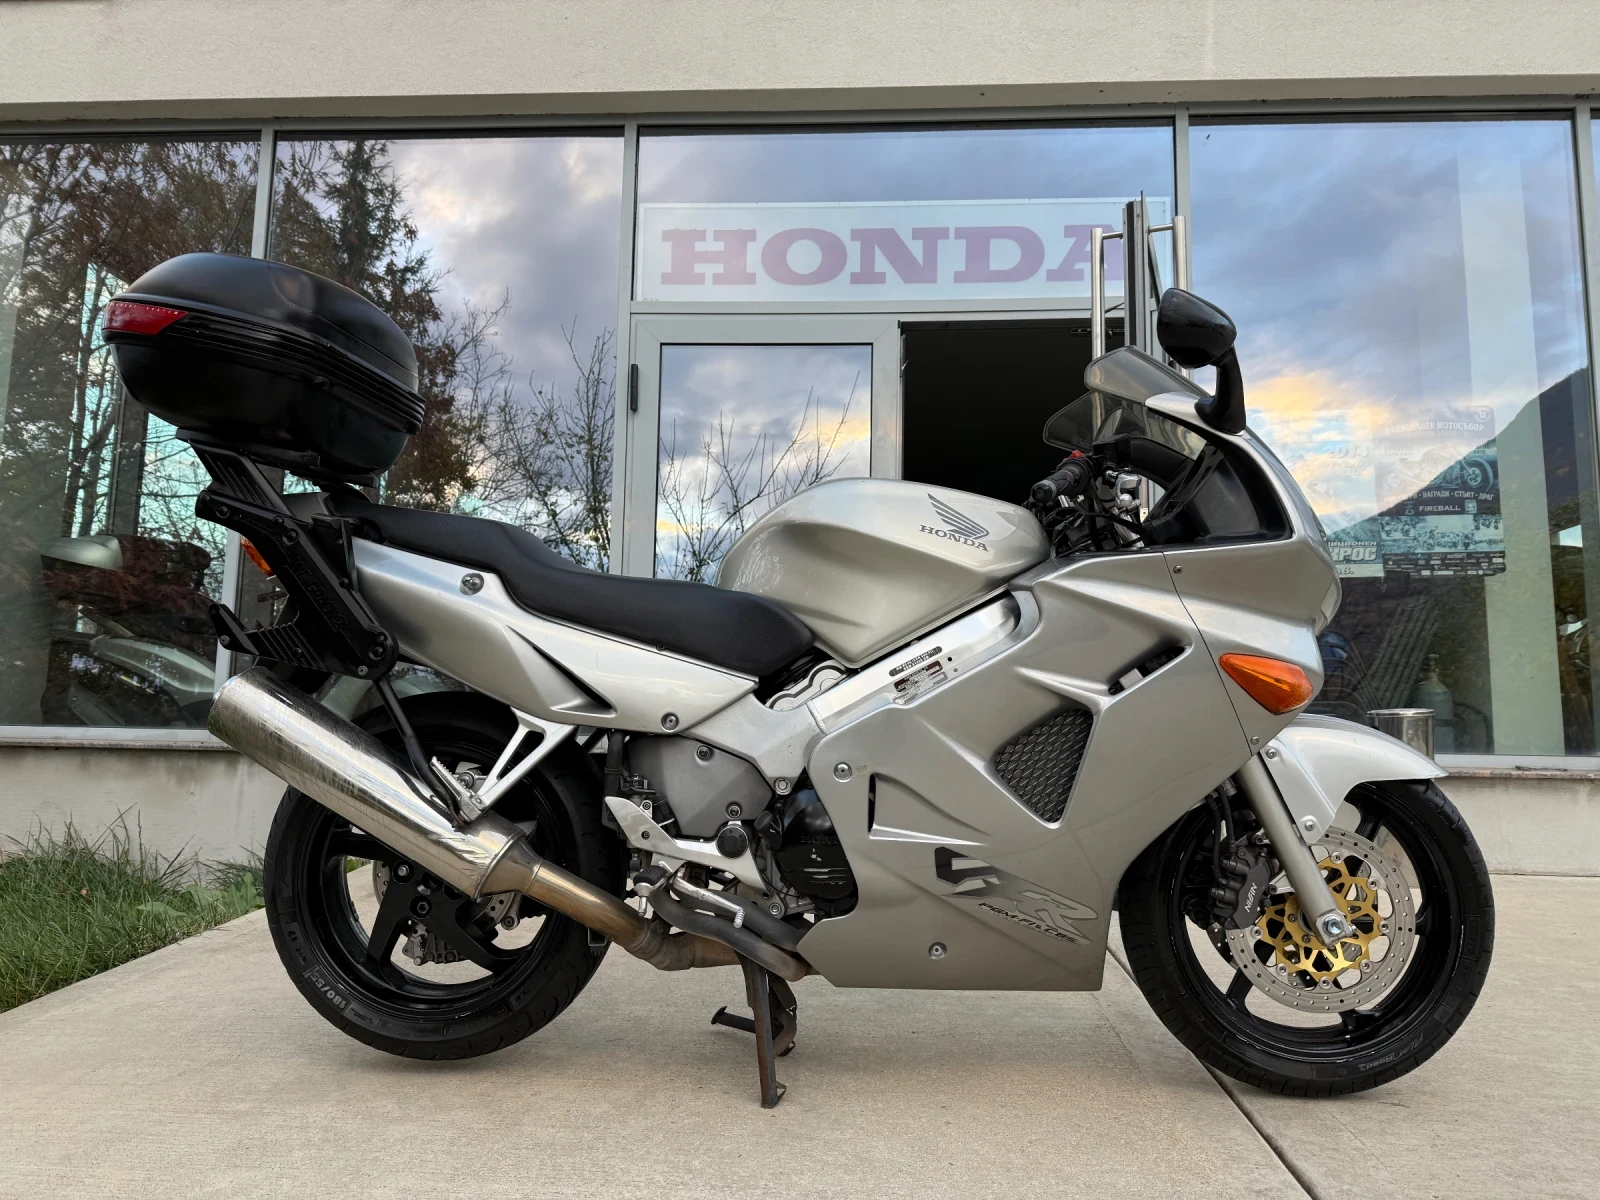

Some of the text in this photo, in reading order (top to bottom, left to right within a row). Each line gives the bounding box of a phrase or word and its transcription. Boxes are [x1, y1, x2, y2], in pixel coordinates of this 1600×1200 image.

[661, 224, 1124, 286] HONDA
[1436, 421, 1485, 432] МОТОСЪБОР
[1418, 503, 1461, 512] FIREBALL
[919, 524, 990, 552] HONDA
[309, 970, 348, 1010] 180/55
